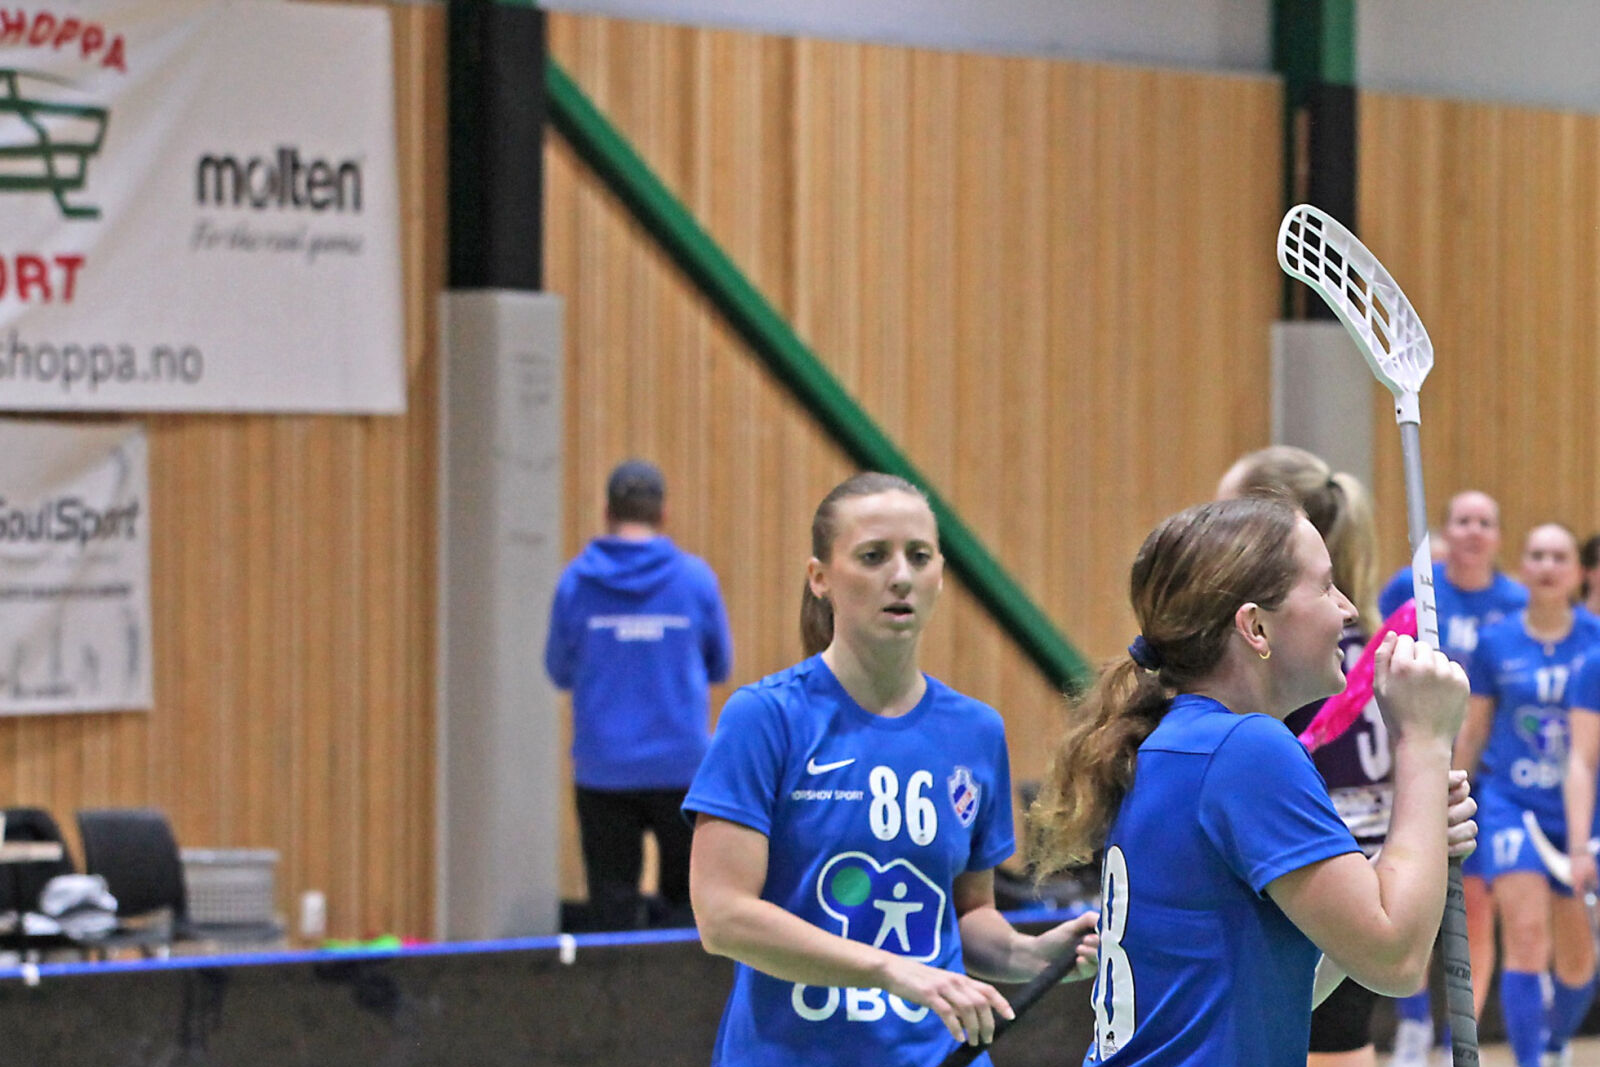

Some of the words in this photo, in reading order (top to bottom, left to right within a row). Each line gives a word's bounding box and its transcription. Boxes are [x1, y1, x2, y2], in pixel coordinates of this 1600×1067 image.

[197, 146, 362, 212] molten
[0, 329, 205, 393] hoppa.no
[834, 789, 864, 801] SPORT
[868, 765, 938, 847] 86
